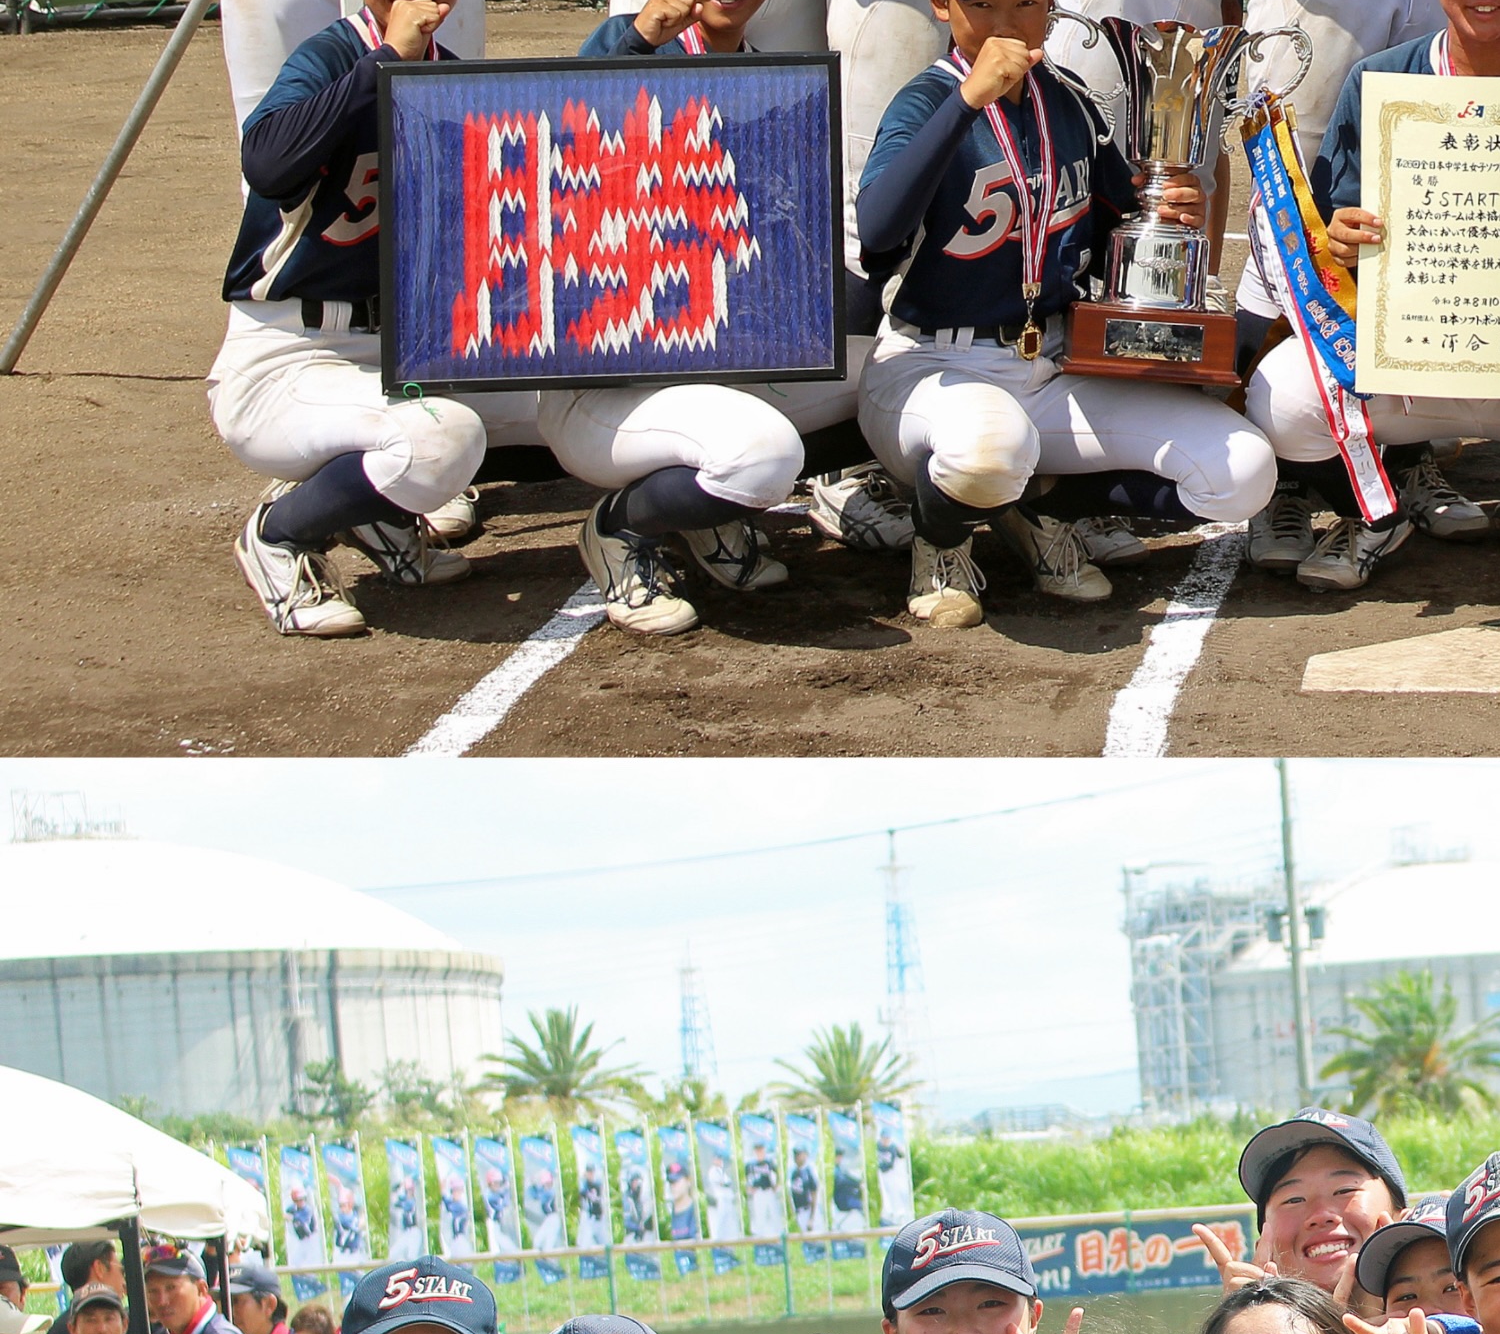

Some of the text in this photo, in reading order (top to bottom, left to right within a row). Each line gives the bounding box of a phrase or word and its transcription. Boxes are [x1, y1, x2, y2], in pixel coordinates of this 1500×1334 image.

[1411, 174, 1439, 187] 優勝
[1406, 242, 1480, 254] おさめられました
[1404, 271, 1458, 284] 表彰します
[910, 1224, 1000, 1270] 5START
[379, 1268, 473, 1309] 5START
